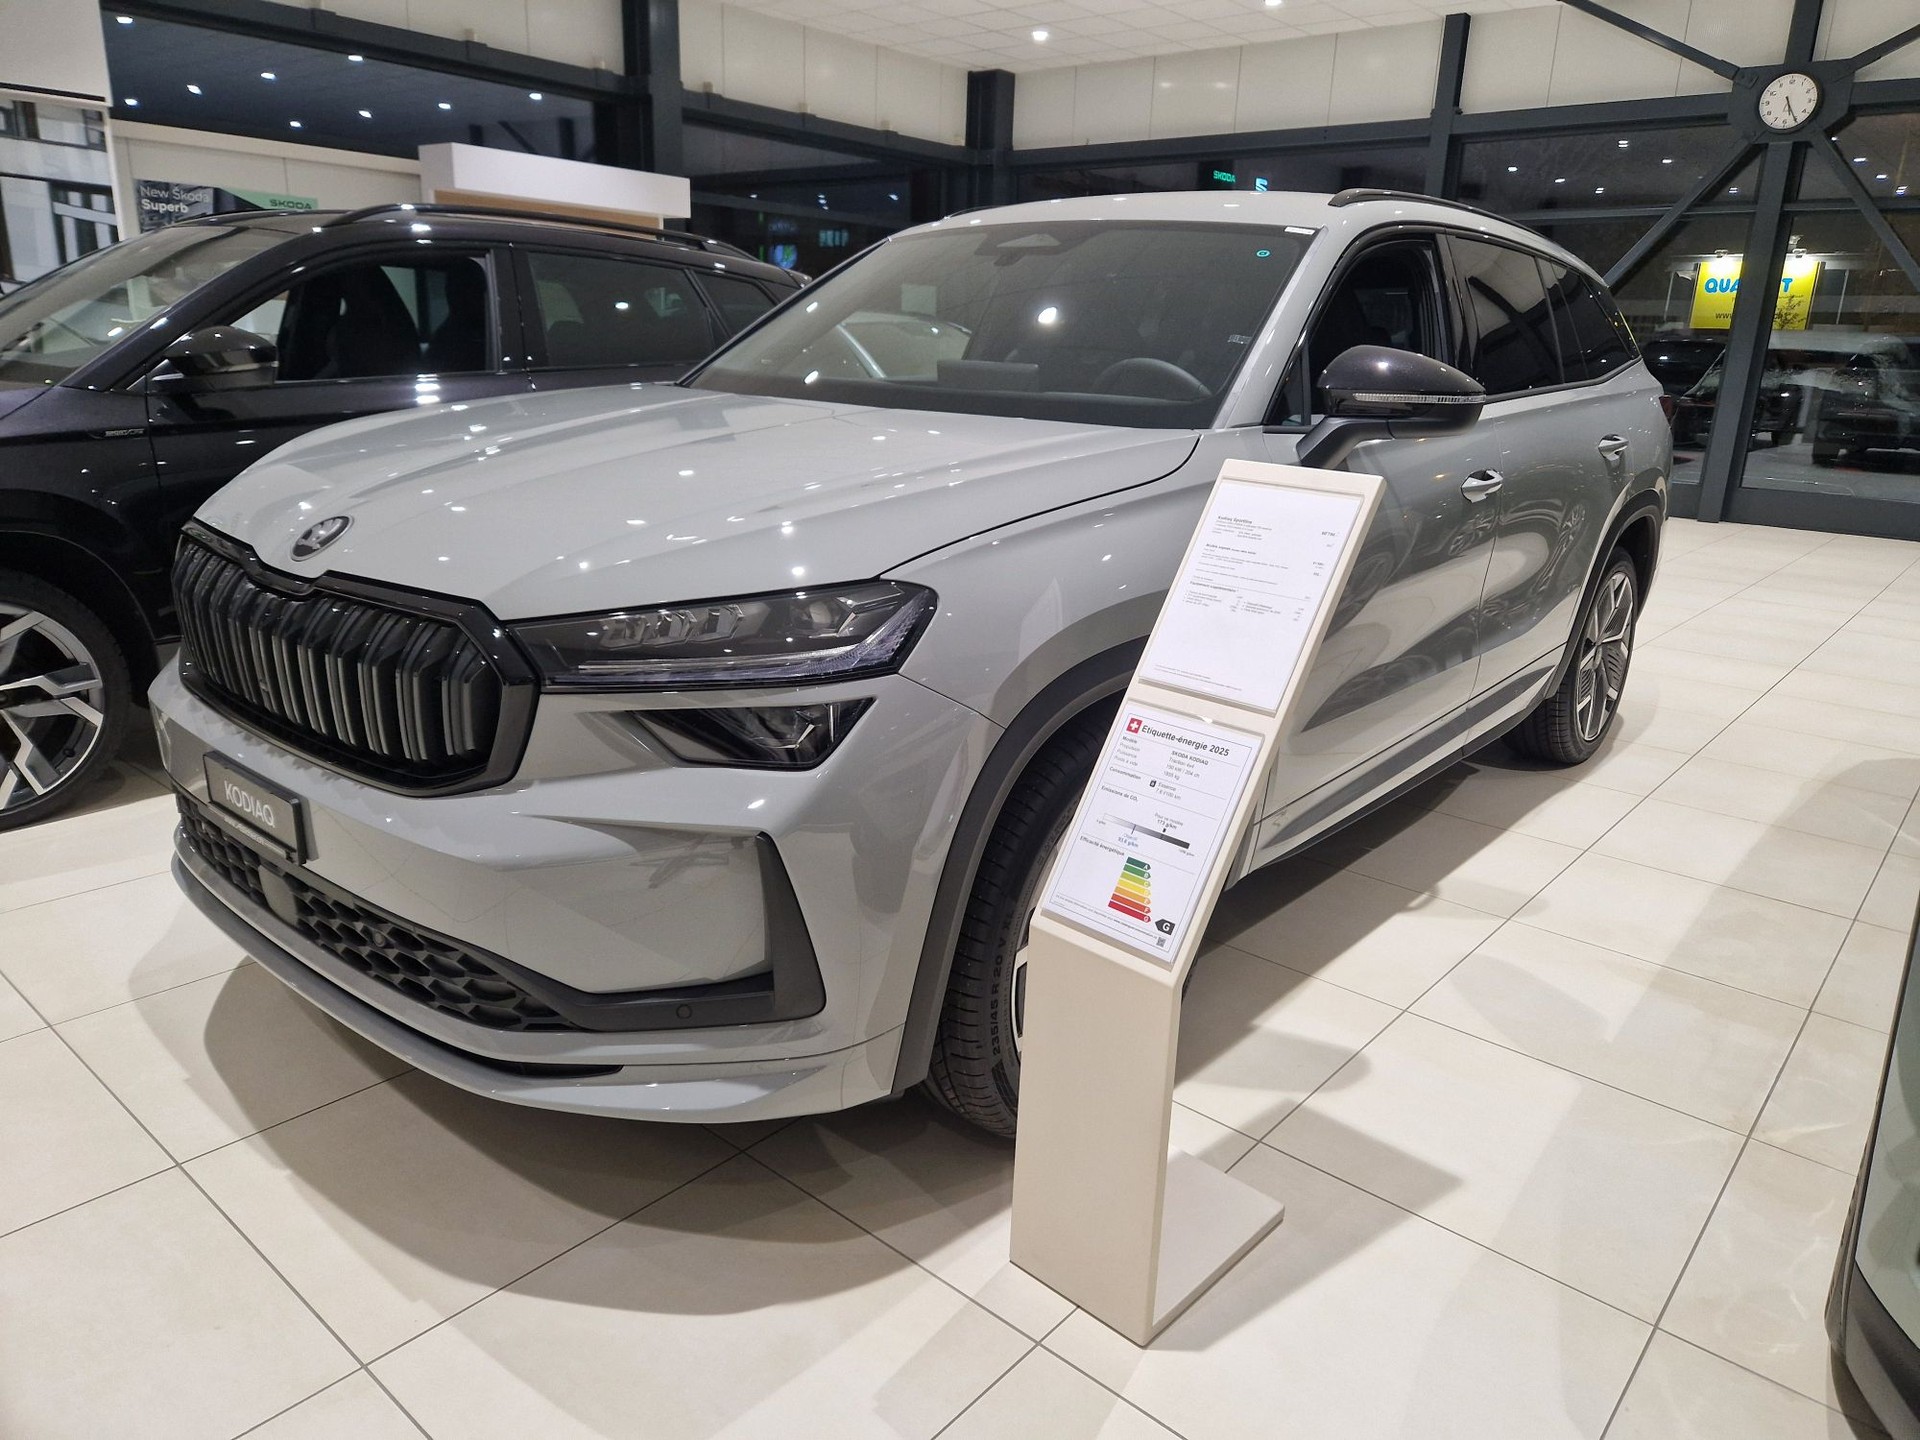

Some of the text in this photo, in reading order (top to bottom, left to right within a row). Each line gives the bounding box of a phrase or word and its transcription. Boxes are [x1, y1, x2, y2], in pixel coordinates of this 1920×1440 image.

[140, 186, 168, 199] New
[142, 199, 189, 213] Superb
[1142, 725, 1230, 756] Etiquette-énergie 2025
[224, 780, 276, 828] KODIAQ
[1162, 922, 1170, 932] G
